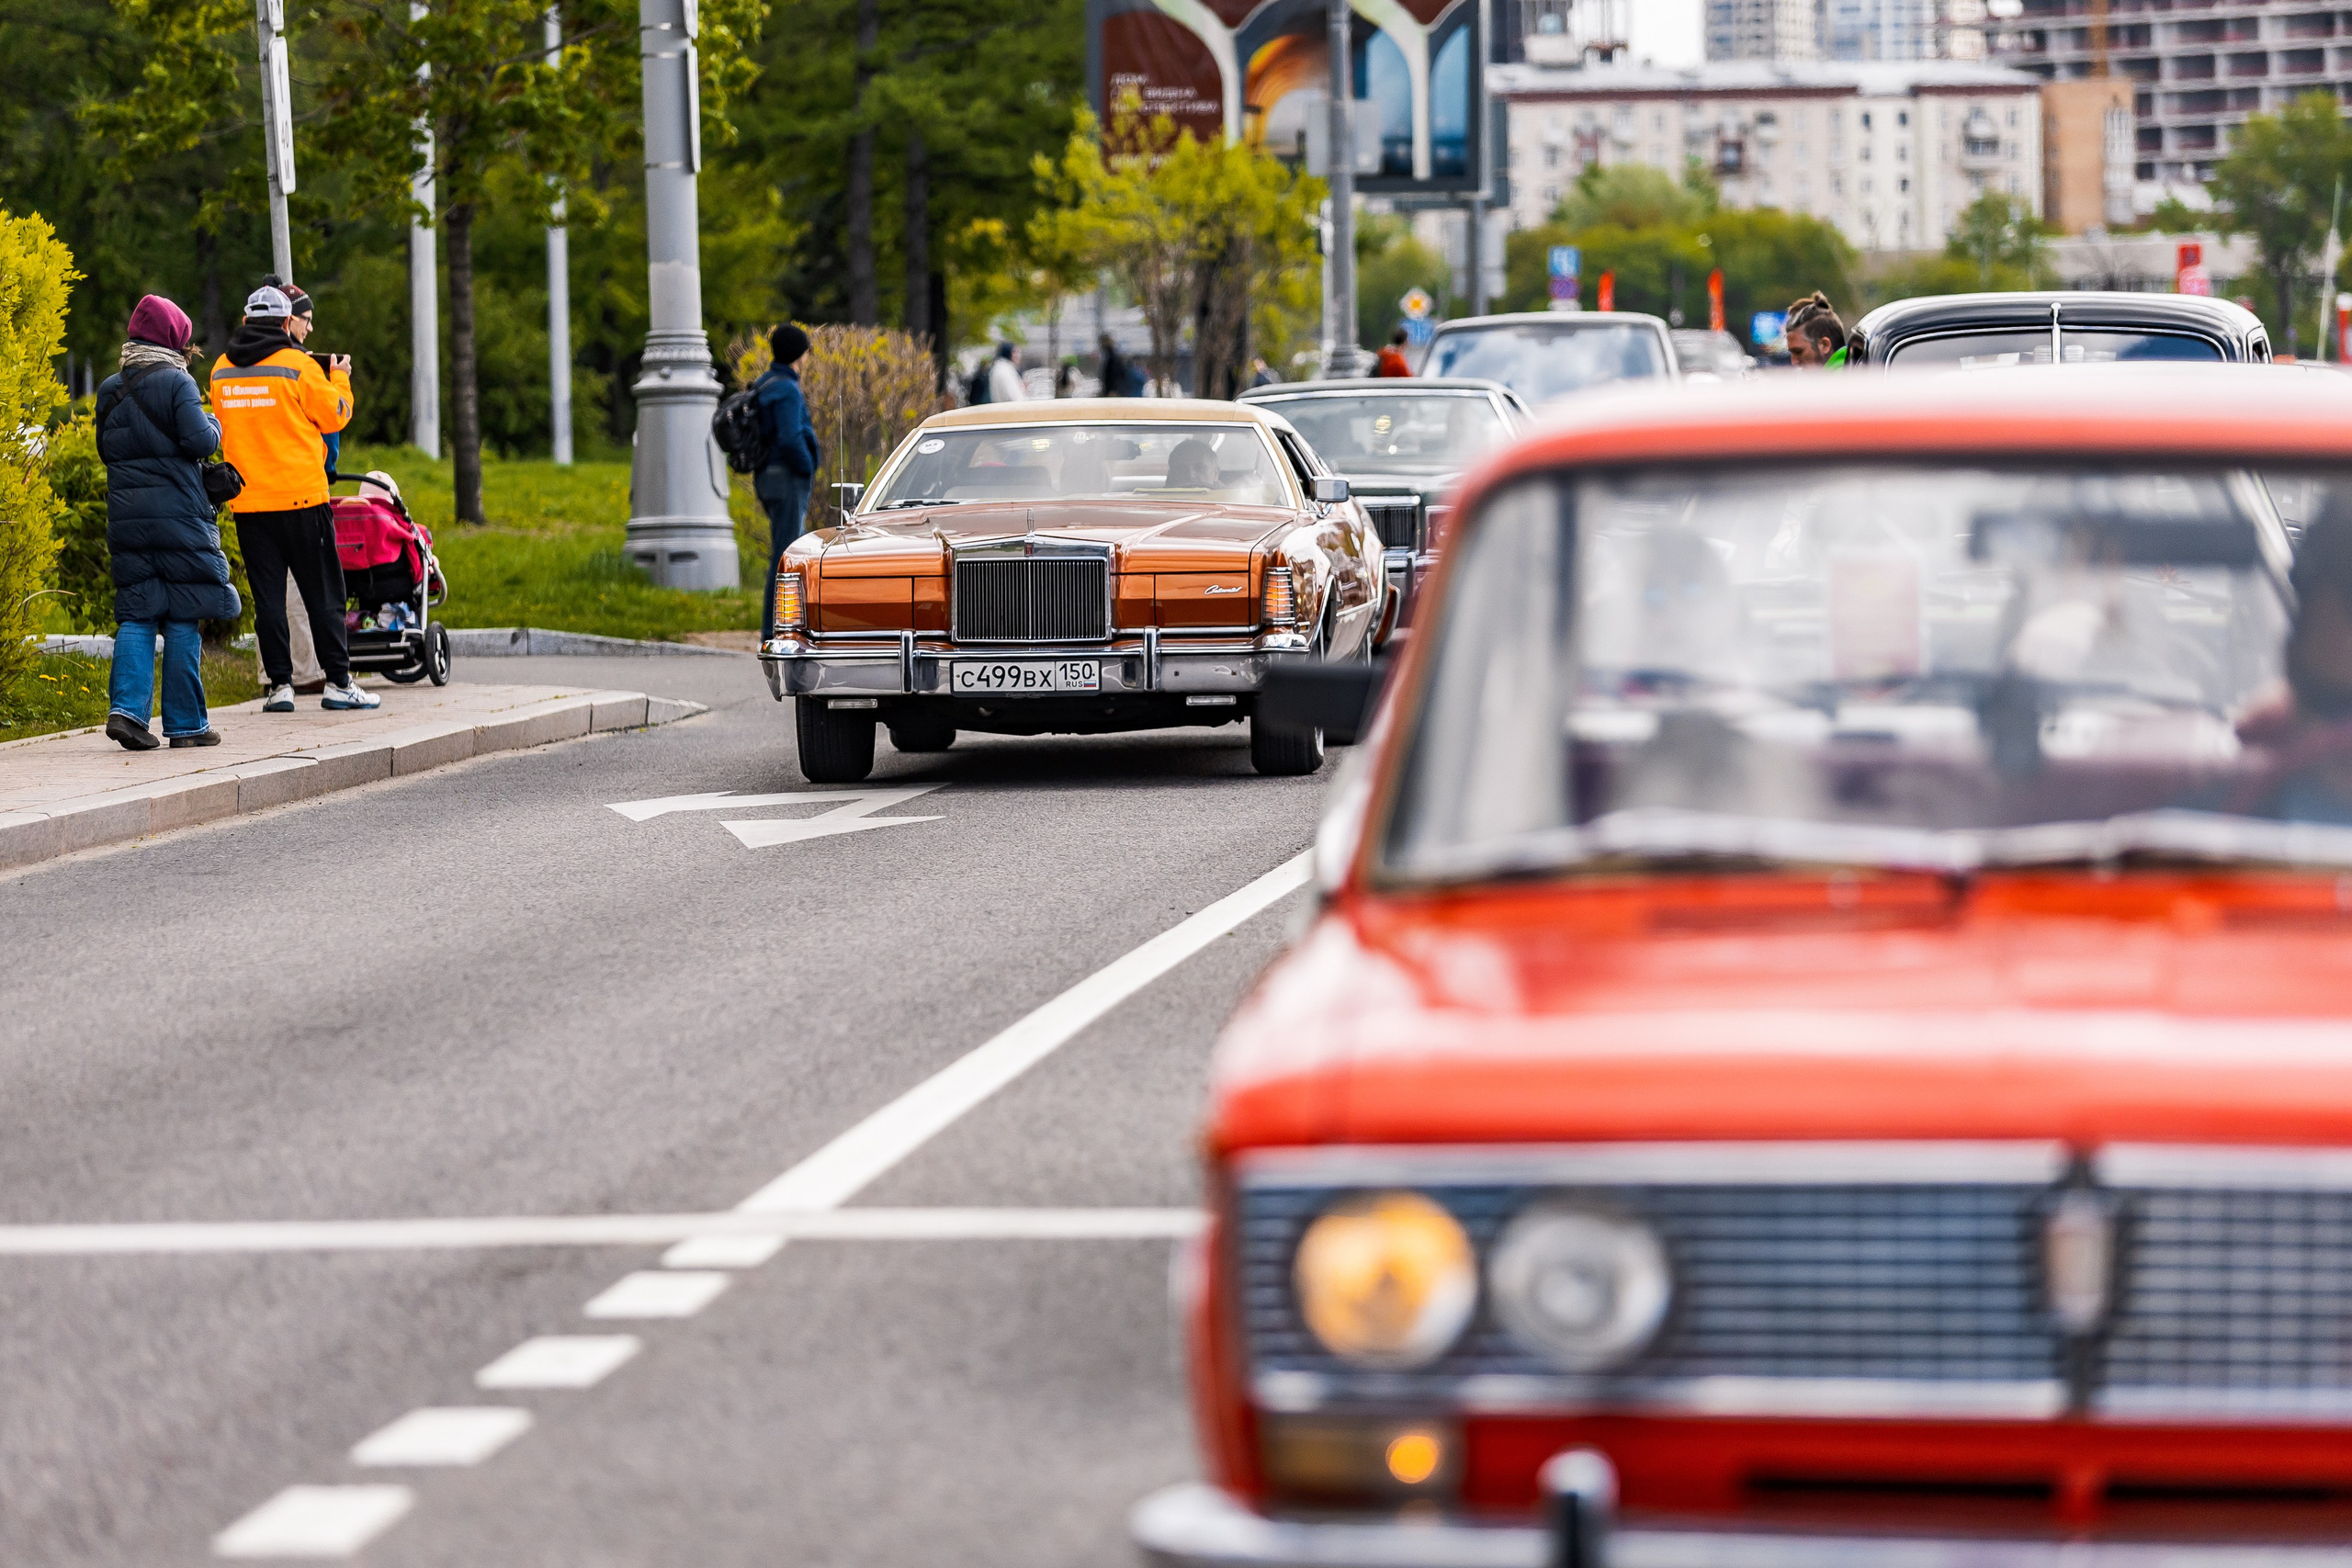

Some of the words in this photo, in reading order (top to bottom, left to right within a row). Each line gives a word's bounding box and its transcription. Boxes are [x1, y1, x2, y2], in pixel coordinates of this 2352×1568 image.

[222, 386, 232, 396] ГБУ
[961, 665, 1053, 688] С499ВХ
[1058, 662, 1093, 681] 150
